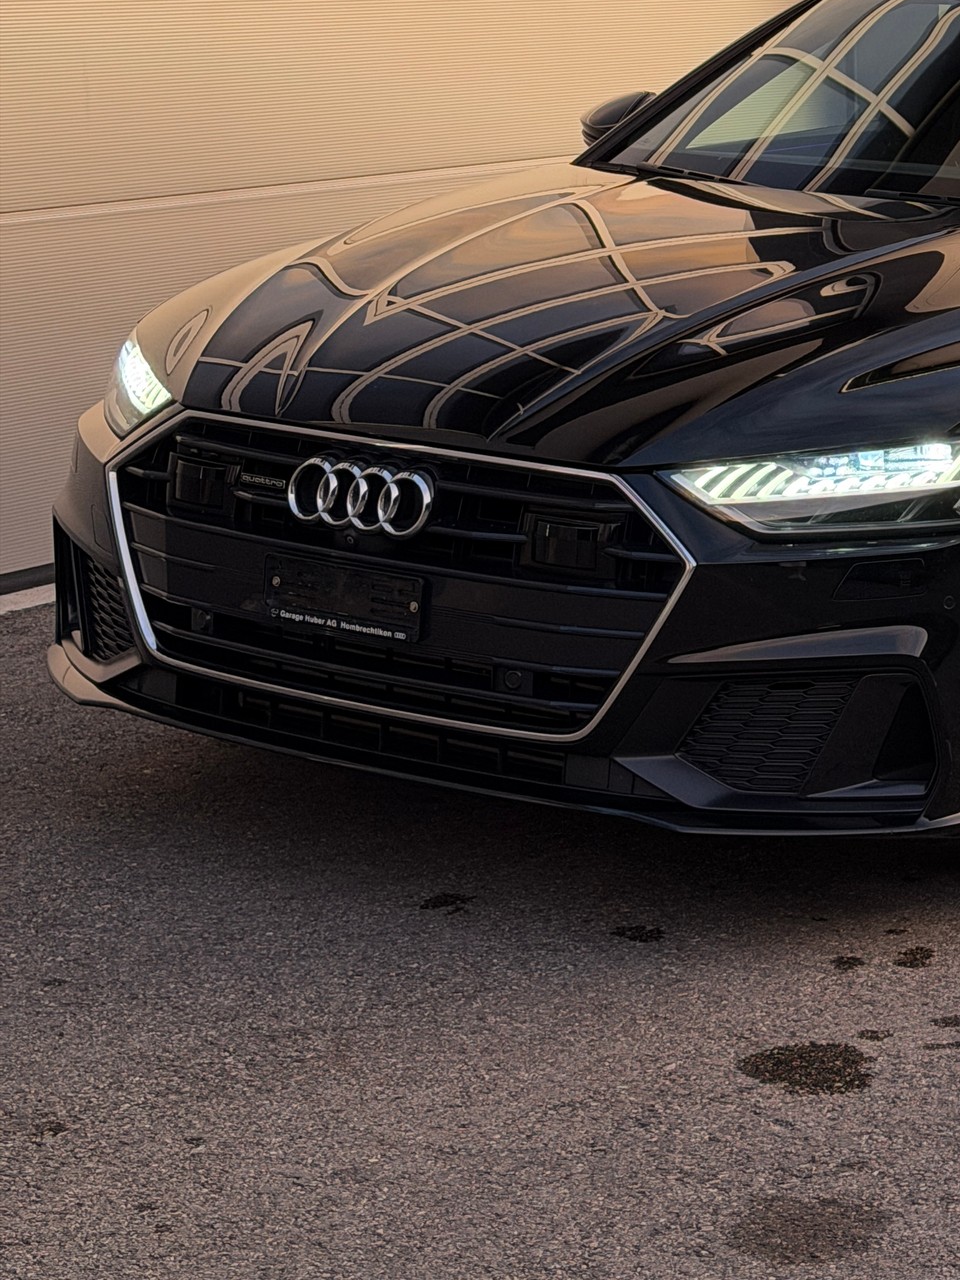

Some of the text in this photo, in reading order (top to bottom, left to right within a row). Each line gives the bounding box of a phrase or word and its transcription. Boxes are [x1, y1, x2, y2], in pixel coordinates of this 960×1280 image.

[242, 475, 283, 487] quattro
[280, 610, 304, 622] Garage
[304, 614, 325, 625] Huber
[326, 618, 337, 627] AG
